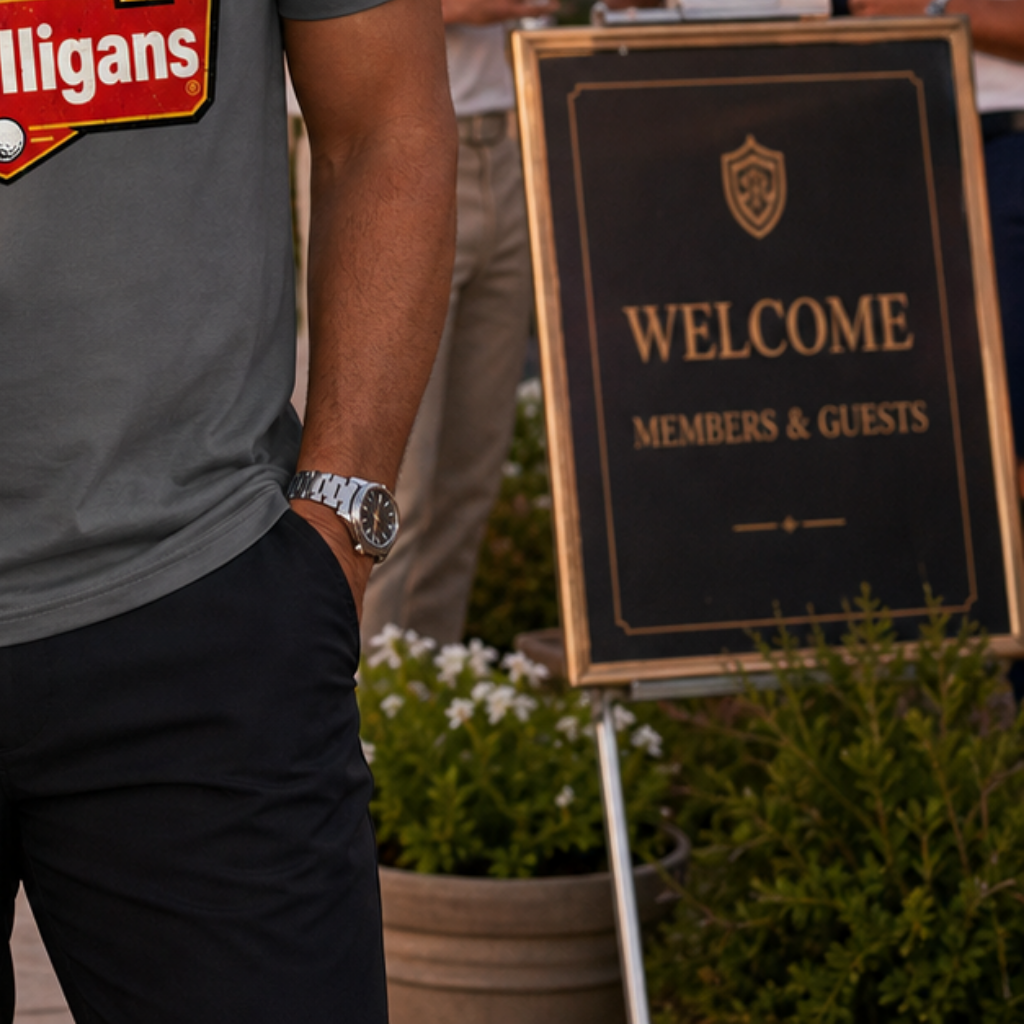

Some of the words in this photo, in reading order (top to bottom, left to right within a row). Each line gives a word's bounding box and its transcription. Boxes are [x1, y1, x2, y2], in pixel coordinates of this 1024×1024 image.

[622, 292, 915, 364] WELCOME
[632, 408, 779, 450] MEMBERS
[785, 406, 811, 440] &
[817, 400, 930, 438] GUESTS
